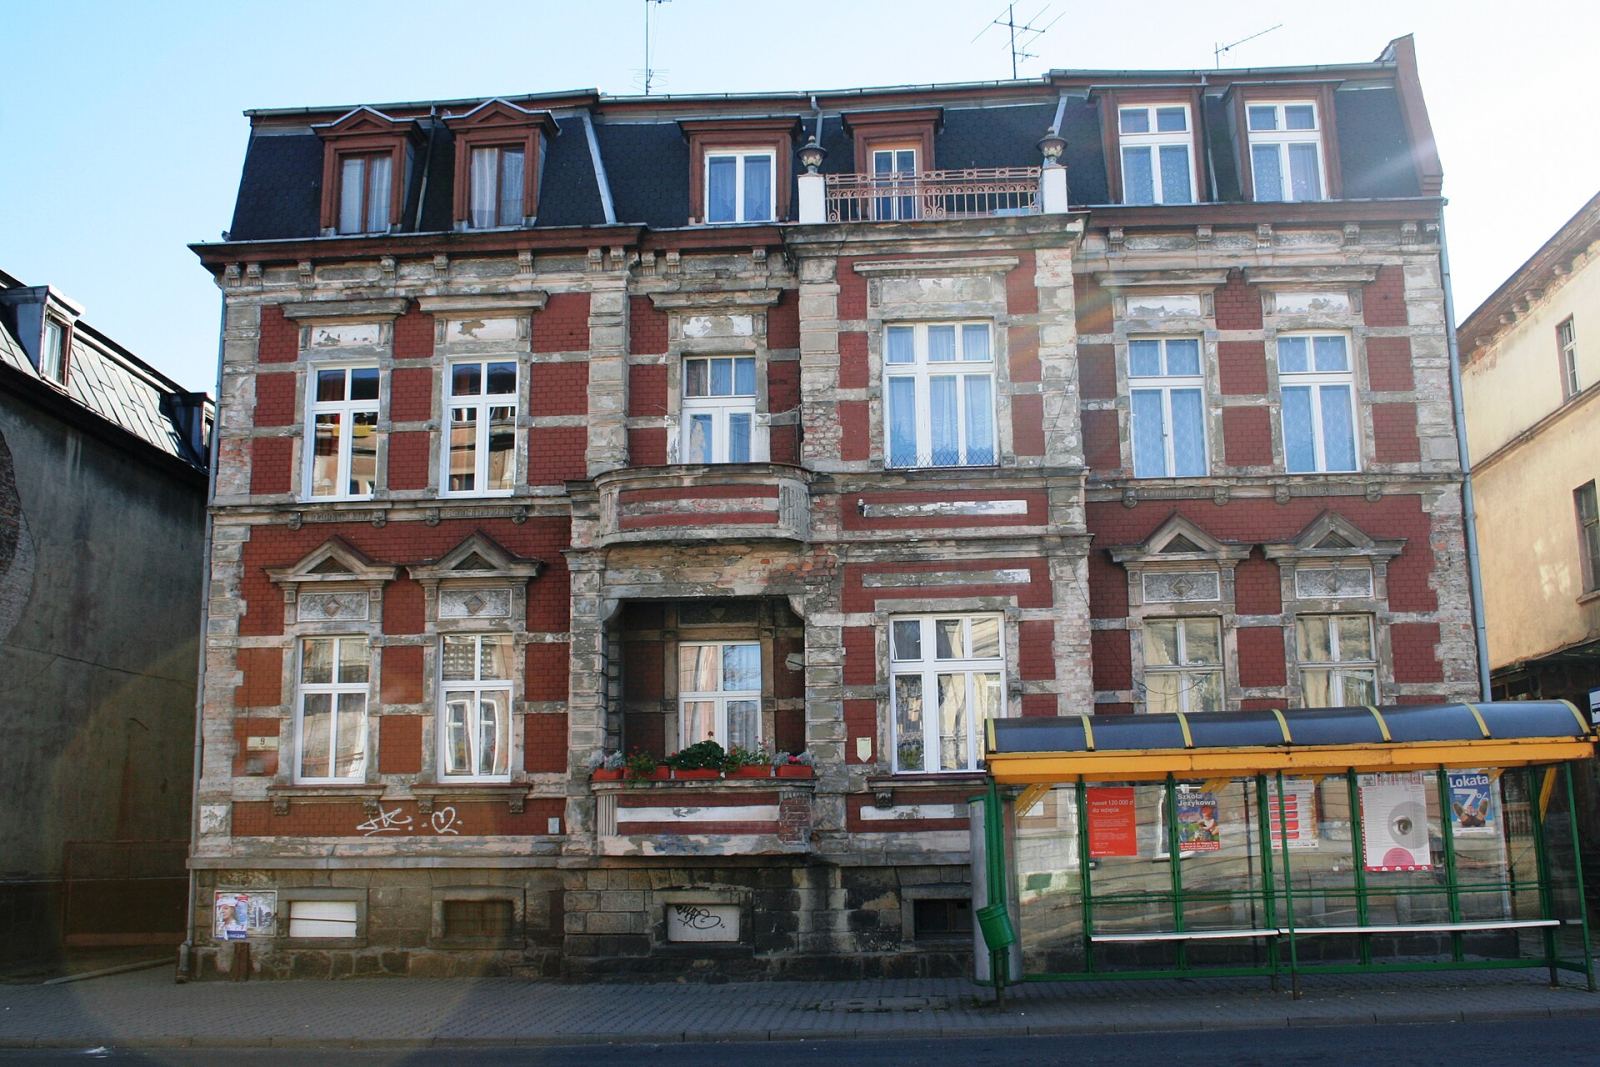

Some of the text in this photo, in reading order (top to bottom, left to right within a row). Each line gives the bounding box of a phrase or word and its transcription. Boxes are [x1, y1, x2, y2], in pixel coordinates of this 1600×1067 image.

[259, 737, 266, 745] 9
[1449, 775, 1489, 788] Lokata
[1177, 799, 1216, 807] Językowa
